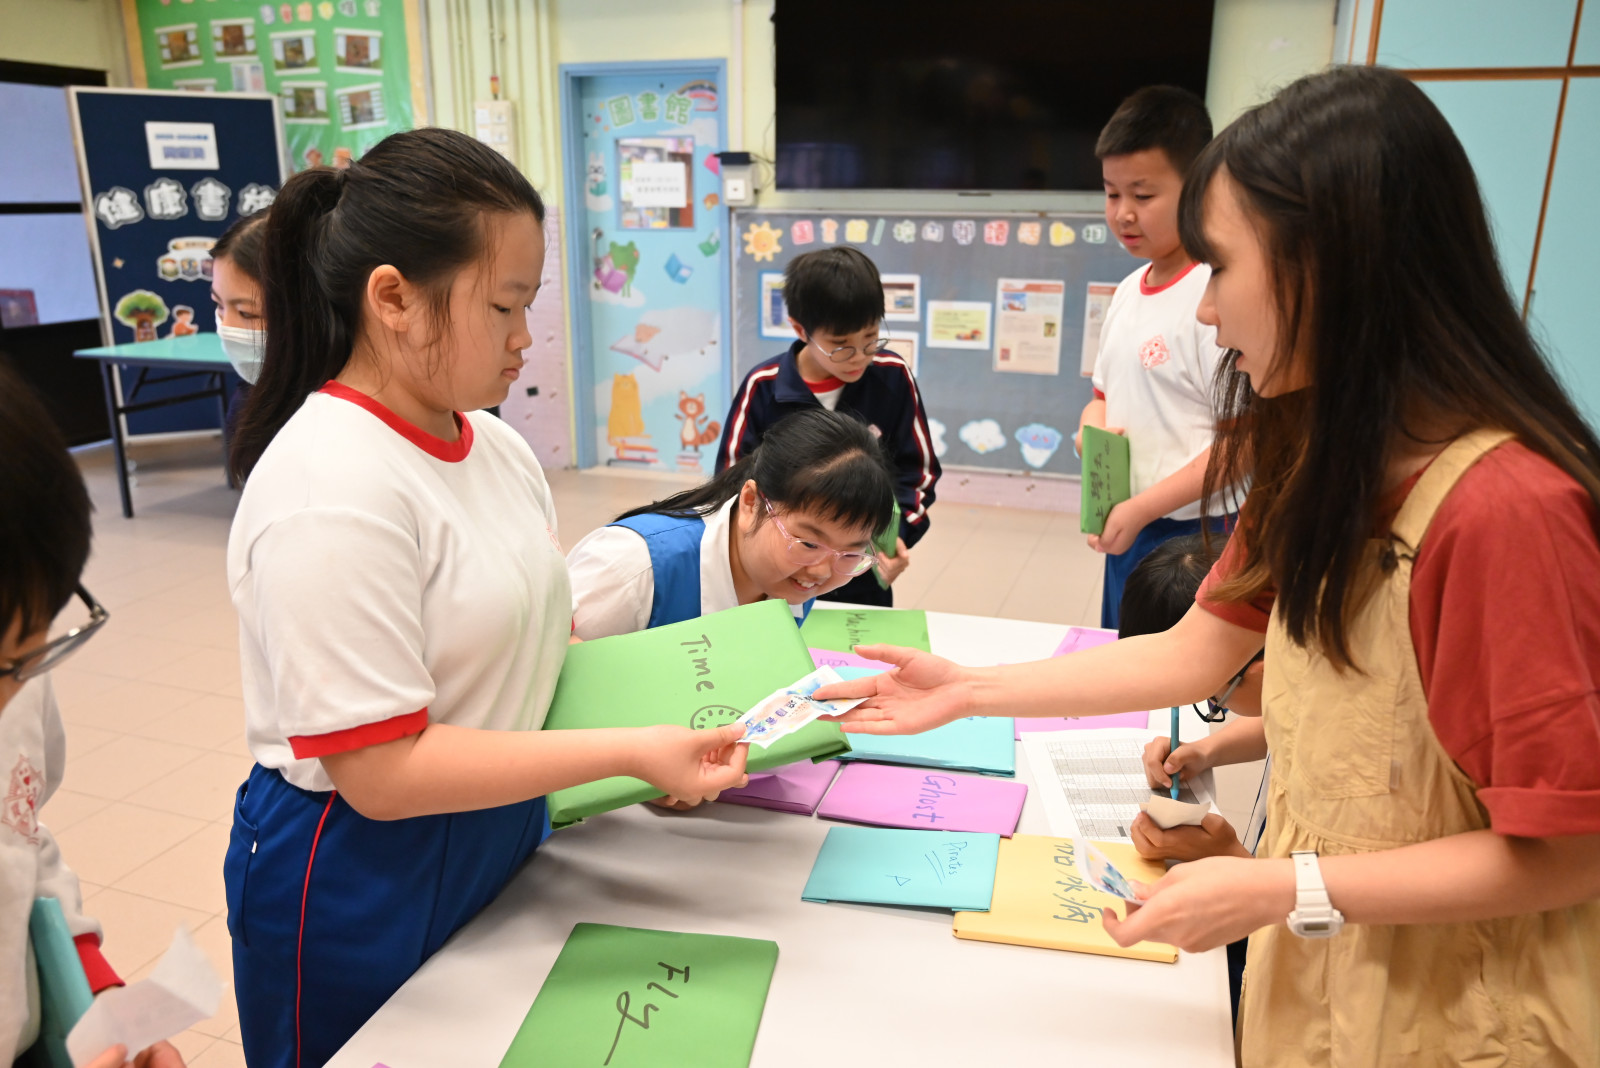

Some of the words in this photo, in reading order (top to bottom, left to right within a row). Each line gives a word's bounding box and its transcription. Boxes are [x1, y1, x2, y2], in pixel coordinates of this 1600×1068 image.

[607, 92, 693, 127] 圖書館
[679, 634, 716, 692] Time
[911, 775, 957, 823] Ghost
[942, 841, 968, 876] Pirates
[603, 961, 690, 1067] Fly
